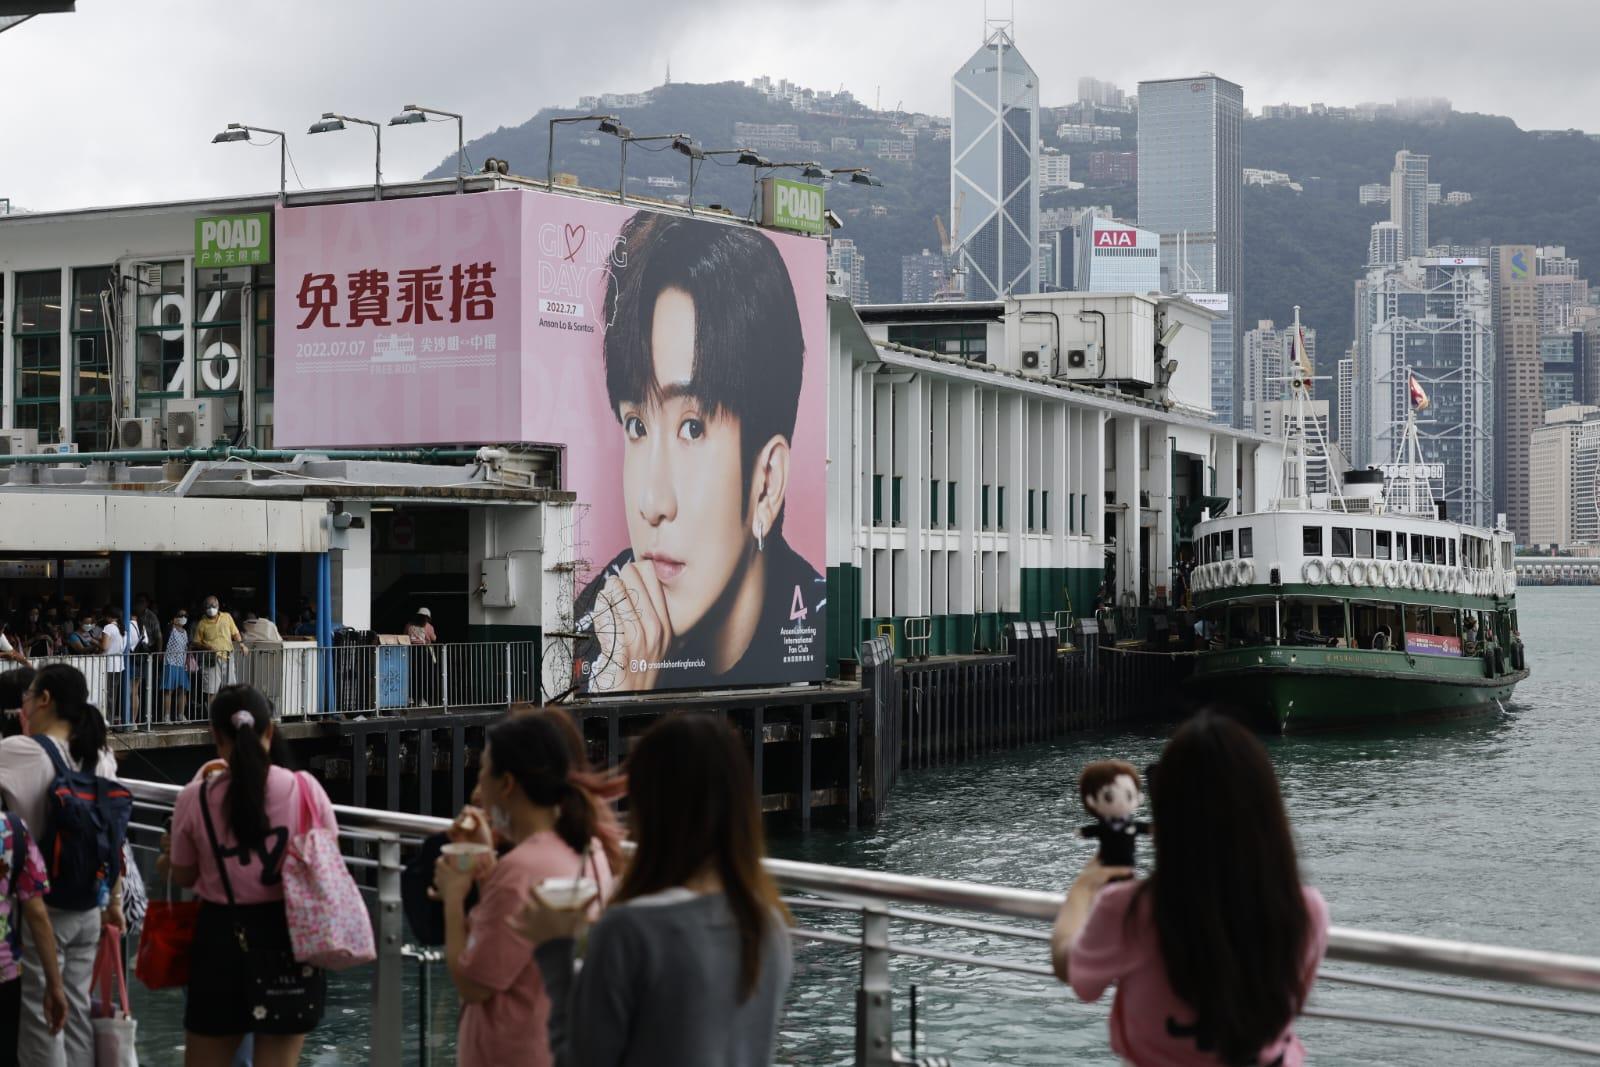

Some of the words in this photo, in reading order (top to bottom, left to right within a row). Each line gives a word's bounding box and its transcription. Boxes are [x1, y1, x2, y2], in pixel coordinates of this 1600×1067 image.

[776, 184, 821, 221] POAD
[201, 218, 261, 250] POAD
[1098, 231, 1132, 246] AIA
[538, 260, 586, 298] DAY
[296, 261, 497, 330] 免費乘搭
[546, 301, 577, 315] 2022.7.7
[538, 318, 559, 330] Anson
[559, 319, 567, 330] Lo
[567, 320, 573, 331] &
[295, 340, 366, 358] 2022.07.07
[370, 363, 393, 375] FREE
[394, 362, 417, 374] RIDE
[783, 635, 814, 645] International
[788, 645, 798, 654] Fan
[798, 644, 809, 653] Club
